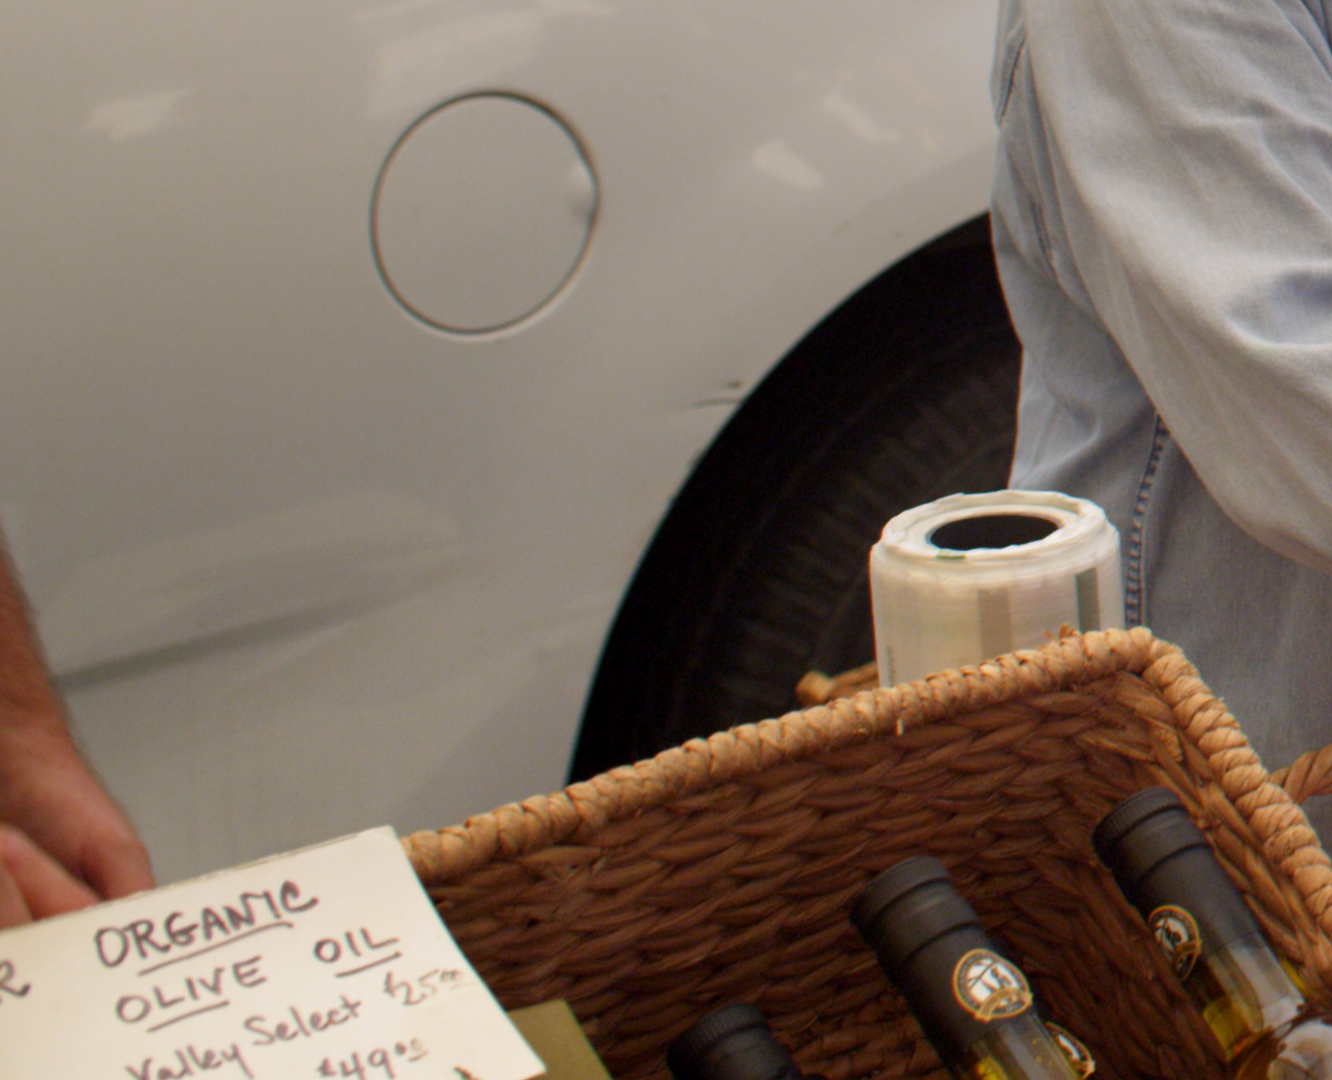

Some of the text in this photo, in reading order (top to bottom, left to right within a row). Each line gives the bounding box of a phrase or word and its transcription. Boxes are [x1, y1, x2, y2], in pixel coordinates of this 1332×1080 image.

[93, 881, 320, 969] ORGANIC
[116, 926, 400, 1024] OLIVE OIL
[126, 1043, 255, 1080] Valley
[243, 995, 362, 1048] Select
